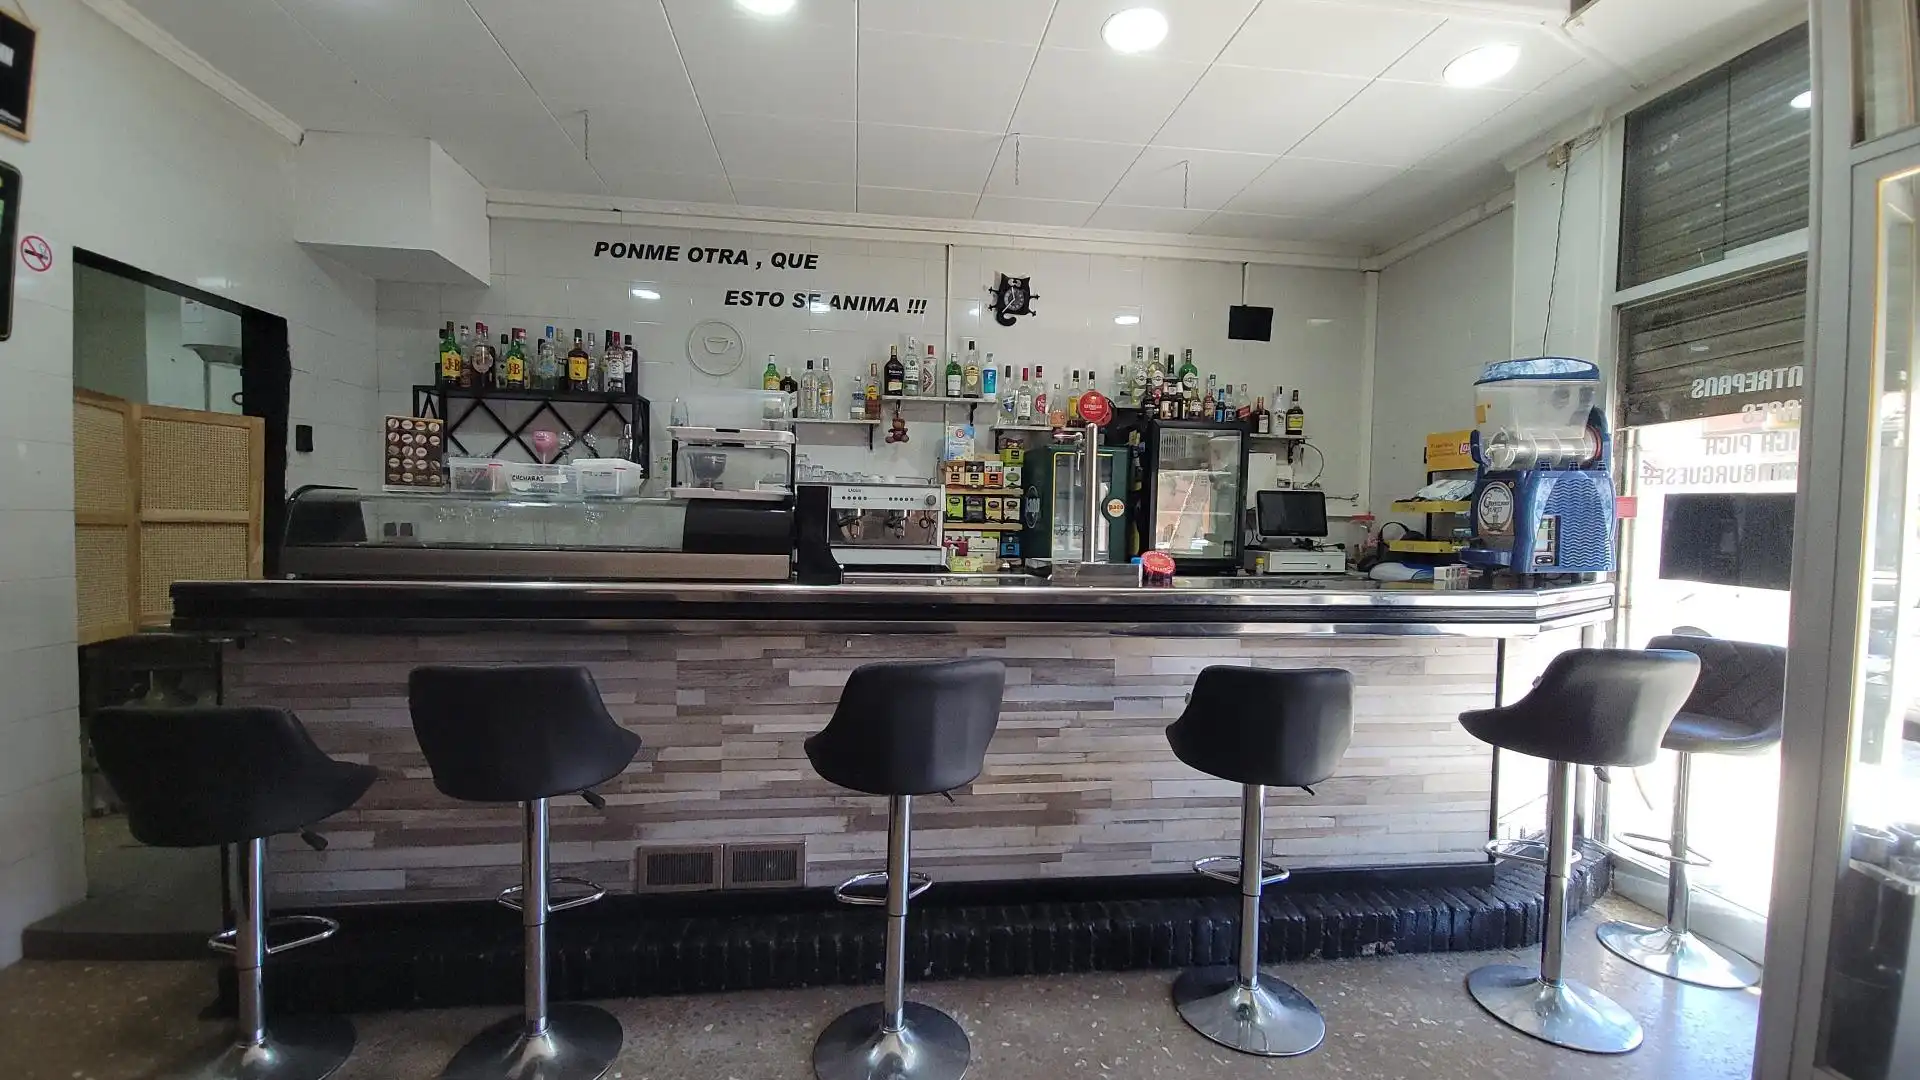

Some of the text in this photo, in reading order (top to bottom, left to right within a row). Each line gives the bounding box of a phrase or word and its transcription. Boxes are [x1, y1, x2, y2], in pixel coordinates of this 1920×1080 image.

[593, 241, 680, 262] PONME
[687, 247, 750, 266] OTRA
[770, 252, 819, 270] QUE
[724, 289, 928, 315] ESTO SE ANIMA !!!
